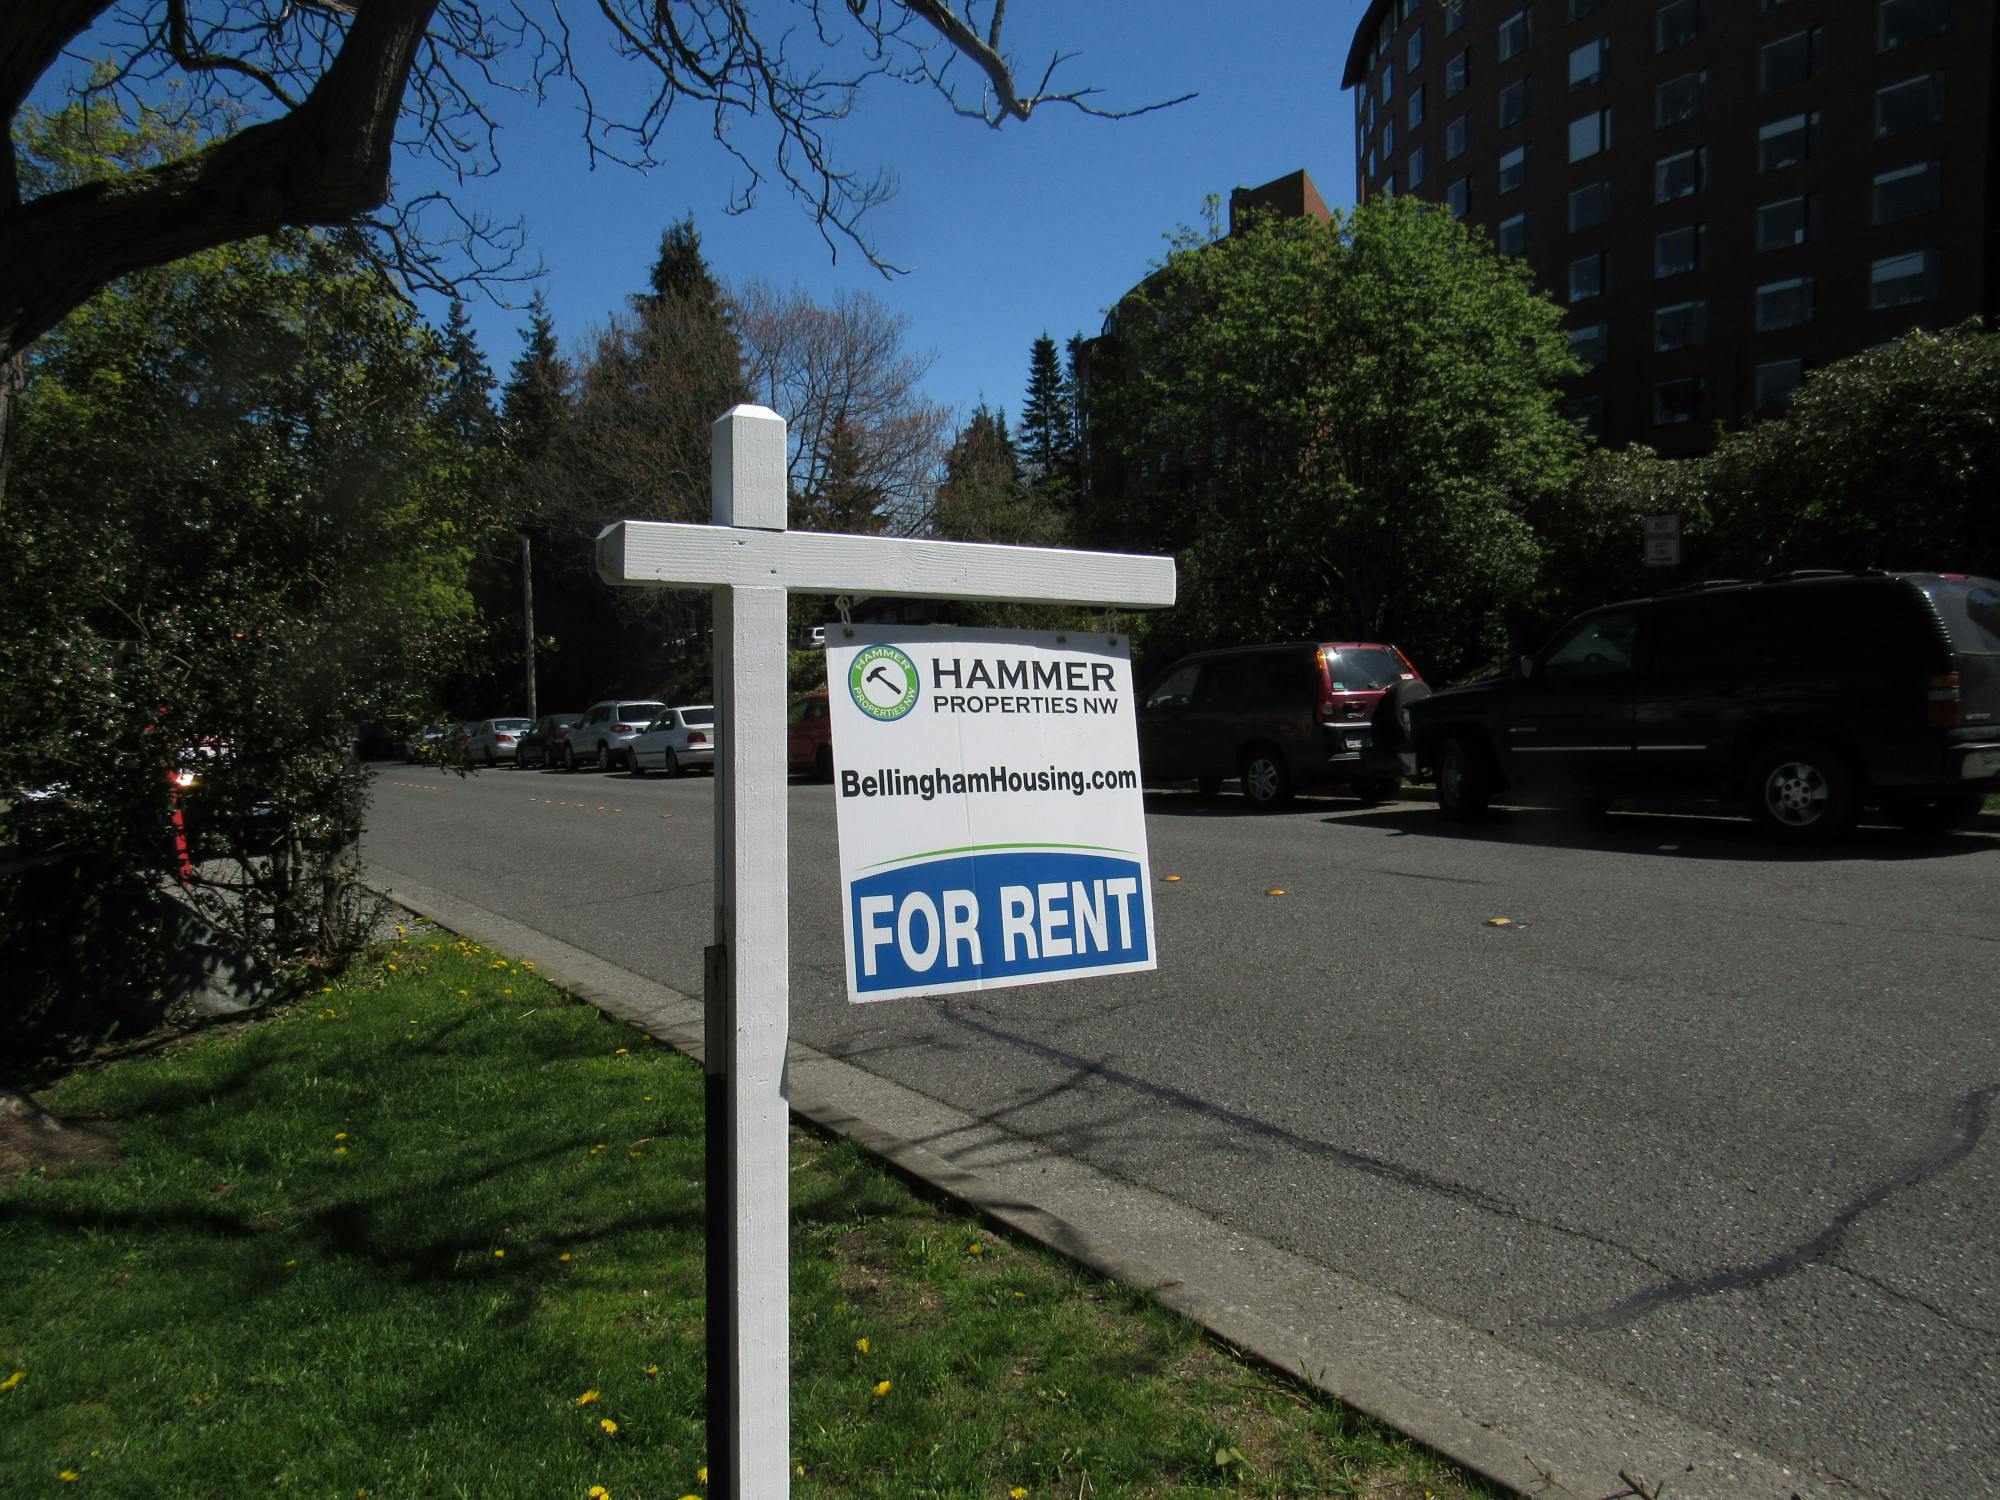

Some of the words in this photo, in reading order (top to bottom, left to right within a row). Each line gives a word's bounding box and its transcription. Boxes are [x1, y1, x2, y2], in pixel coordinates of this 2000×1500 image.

[855, 649, 910, 670] HAMMER
[932, 658, 1117, 692] HAMMER
[854, 687, 906, 717] PROPERTIES
[903, 687, 916, 707] NW
[933, 695, 1078, 714] PROPERTIES
[1083, 698, 1119, 714] NW
[841, 766, 1137, 800] BellinghamHousing.com
[860, 889, 984, 977] FOR
[1000, 877, 1137, 962] RENT
